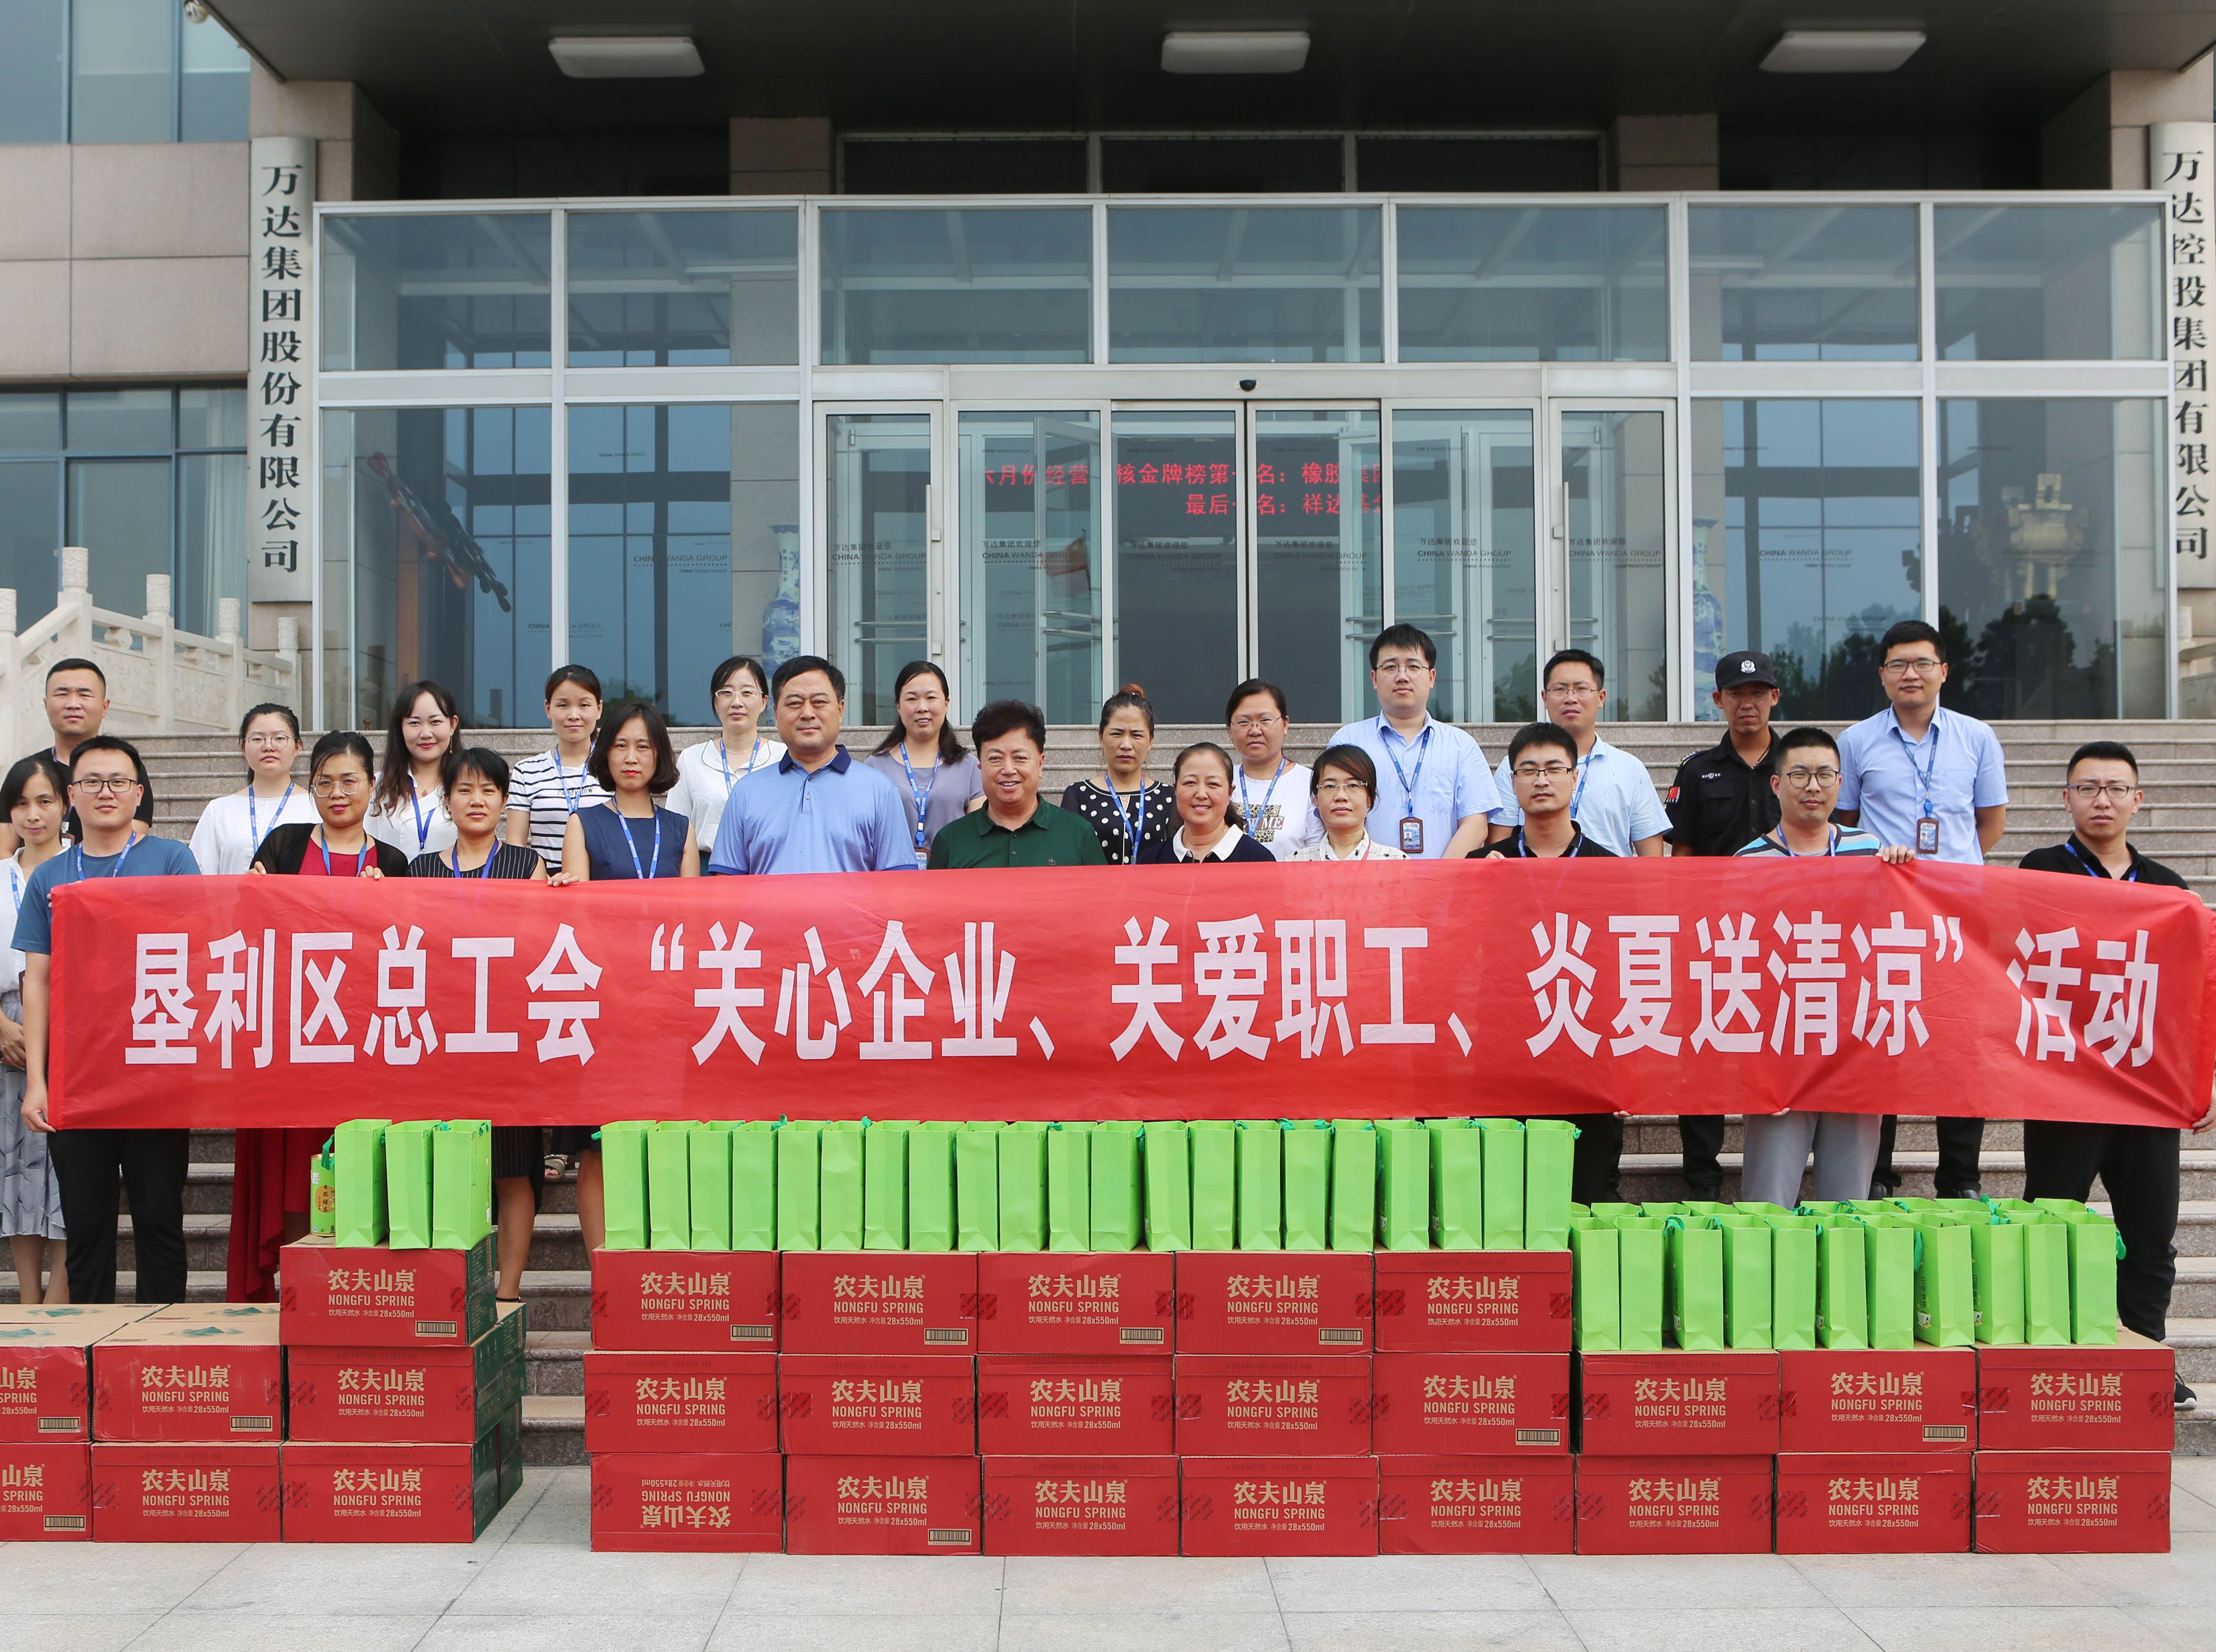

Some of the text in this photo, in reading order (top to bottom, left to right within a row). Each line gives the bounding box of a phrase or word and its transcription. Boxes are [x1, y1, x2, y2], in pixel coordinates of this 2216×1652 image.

[260, 164, 302, 574] 万达集团股份有限公司
[328, 1268, 416, 1292] 农夫山泉
[640, 1271, 731, 1296] 农夫山泉
[1028, 1274, 1120, 1298] 农夫山泉
[833, 1274, 925, 1299] 农夫山泉
[1227, 1274, 1320, 1299] 农夫山泉
[1427, 1275, 1519, 1300] 农夫山泉
[328, 1294, 414, 1306] NONGFU SPRING
[641, 1298, 729, 1310] NONGFU SPRING
[834, 1301, 924, 1313] NONGFU SPRING
[1029, 1301, 1119, 1313] NONGFU SPRING
[1227, 1301, 1318, 1313] NONGFU SPRING
[1428, 1303, 1518, 1314] NONGFU SPRING
[141, 1365, 230, 1388] 农夫山泉
[337, 1368, 425, 1392] 农夫山泉
[635, 1376, 726, 1401] 农夫山泉
[1423, 1374, 1516, 1400] 农夫山泉
[1634, 1377, 1727, 1402] 农夫山泉
[1831, 1371, 1923, 1396] 农夫山泉
[2030, 1372, 2122, 1397] 农夫山泉
[832, 1379, 923, 1403] 农夫山泉
[1030, 1378, 1122, 1402] 农夫山泉
[1227, 1379, 1319, 1404] 农夫山泉
[0, 1392, 37, 1403] SPRING
[142, 1391, 229, 1402] NONGFU SPRING
[339, 1394, 424, 1406] NONGFU SPRING
[637, 1404, 725, 1415] NONGFU SPRING
[1424, 1402, 1515, 1414] NONGFU SPRING
[1831, 1399, 1922, 1410] NONGFU SPRING
[2031, 1400, 2121, 1411] NONGFU SPRING
[832, 1406, 922, 1418] NONGFU SPRING
[1031, 1406, 1121, 1417] NONGFU SPRING
[1227, 1406, 1318, 1418] NONGFU SPRING
[1635, 1405, 1726, 1417] NONGFU SPRING
[141, 1468, 230, 1492] 农夫山泉
[332, 1468, 422, 1492] 农夫山泉
[837, 1475, 928, 1500] 农夫山泉
[1035, 1479, 1127, 1504] 农夫山泉
[1233, 1480, 1326, 1505] 农夫山泉
[1430, 1478, 1522, 1502] 农夫山泉
[1628, 1477, 1720, 1502] 农夫山泉
[1828, 1477, 1919, 1501] 农夫山泉
[2027, 1475, 2118, 1500] 农夫山泉
[3, 1490, 44, 1501] SPRING
[142, 1495, 229, 1506] NONGFU SPRING
[333, 1495, 421, 1506] NONGFU SPRING
[642, 1490, 730, 1502] NONGFU SPRING
[838, 1502, 927, 1514] NONGFU SPRING
[1036, 1507, 1126, 1518] NONGFU SPRING
[1234, 1508, 1325, 1519] NONGFU SPRING
[1431, 1505, 1521, 1516] NONGFU SPRING
[1629, 1504, 1719, 1516] NONGFU SPRING
[1829, 1504, 1919, 1516] NONGFU SPRING
[2028, 1503, 2118, 1514] NONGFU SPRING
